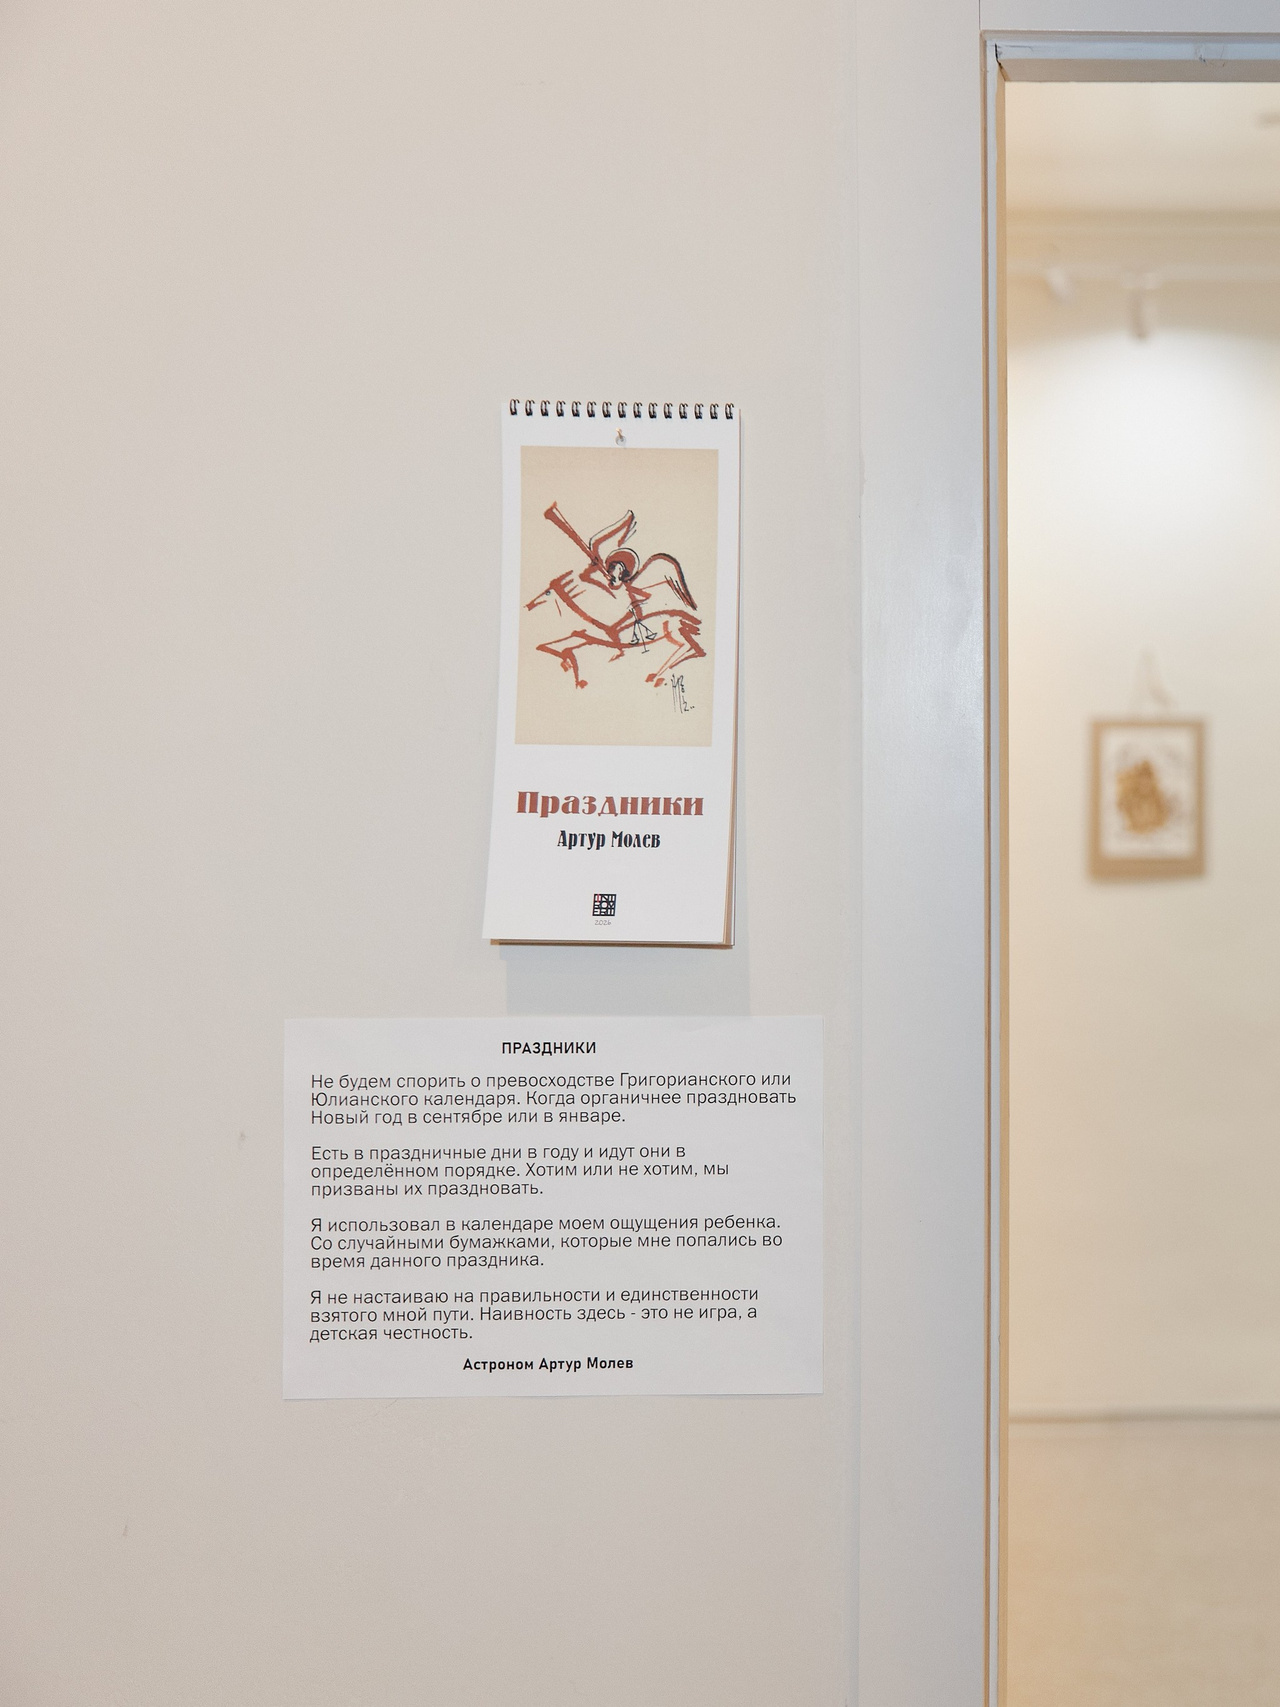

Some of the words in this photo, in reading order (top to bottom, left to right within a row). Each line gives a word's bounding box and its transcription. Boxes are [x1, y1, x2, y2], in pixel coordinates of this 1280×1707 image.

[516, 790, 705, 819] Праздники
[556, 829, 607, 851] Артур
[611, 830, 662, 849] Молев
[501, 1041, 597, 1057] ПРАЗДНИКИ
[311, 1074, 334, 1089] Не
[338, 1073, 391, 1092] будем
[396, 1076, 466, 1091] спорить
[470, 1076, 481, 1088] о
[486, 1075, 615, 1091] превосходстве
[620, 1072, 757, 1090] Григорианского
[761, 1074, 791, 1086] или
[311, 1091, 419, 1107] Юлианского
[424, 1093, 521, 1109] календаря.
[526, 1090, 576, 1108] Когда
[580, 1092, 682, 1108] органичнее
[686, 1092, 797, 1107] праздновать
[311, 1109, 369, 1125] Новый
[374, 1112, 403, 1127] год
[407, 1112, 418, 1124] в
[422, 1108, 503, 1127] сентябре
[507, 1111, 538, 1124] или
[543, 1111, 554, 1123] в
[558, 1110, 626, 1126] январе.
[311, 1145, 349, 1161] Есть
[354, 1148, 364, 1161] в
[369, 1147, 487, 1163] праздничные
[490, 1147, 522, 1162] дни
[527, 1147, 538, 1159] в
[543, 1147, 580, 1162] году
[584, 1147, 593, 1159] и
[599, 1146, 636, 1162] идут
[639, 1146, 670, 1159] они
[676, 1146, 686, 1158] в
[310, 1162, 439, 1182] определённом
[444, 1165, 521, 1181] порядке.
[524, 1162, 577, 1177] Хотим
[583, 1164, 613, 1177] или
[618, 1164, 639, 1176] не
[643, 1164, 698, 1178] хотим,
[703, 1163, 729, 1176] мы
[311, 1184, 399, 1200] призваны
[404, 1184, 423, 1196] их
[427, 1183, 544, 1199] праздновать.
[310, 1217, 322, 1233] Я
[328, 1219, 440, 1233] использовал
[445, 1219, 456, 1232] в
[461, 1218, 554, 1234] календаре
[558, 1218, 605, 1231] моем
[609, 1217, 699, 1233] ощущения
[704, 1214, 781, 1232] ребенка.
[310, 1235, 333, 1251] Со
[337, 1235, 444, 1254] случайными
[449, 1234, 555, 1253] бумажками,
[560, 1235, 633, 1251] которые
[637, 1235, 671, 1248] мне
[676, 1235, 757, 1248] попались
[762, 1234, 783, 1247] во
[310, 1256, 365, 1272] время
[369, 1255, 442, 1271] данного
[446, 1254, 544, 1270] праздника.
[310, 1289, 322, 1305] Я
[327, 1292, 348, 1305] не
[353, 1291, 449, 1305] настаиваю
[453, 1291, 474, 1304] на
[479, 1290, 601, 1306] правильности
[606, 1290, 616, 1302] и
[620, 1289, 759, 1304] единственности
[310, 1310, 378, 1323] взятого
[382, 1306, 427, 1322] мной
[433, 1309, 474, 1325] пути.
[480, 1306, 572, 1321] Наивность
[576, 1308, 626, 1323] здесь
[640, 1307, 669, 1320] это
[673, 1307, 694, 1320] не
[699, 1307, 742, 1322] игра,
[747, 1306, 758, 1319] а
[308, 1328, 378, 1344] детская
[383, 1327, 473, 1340] честность.
[462, 1357, 534, 1374] Астроном
[538, 1357, 582, 1374] Артур
[586, 1356, 634, 1370] Молев
